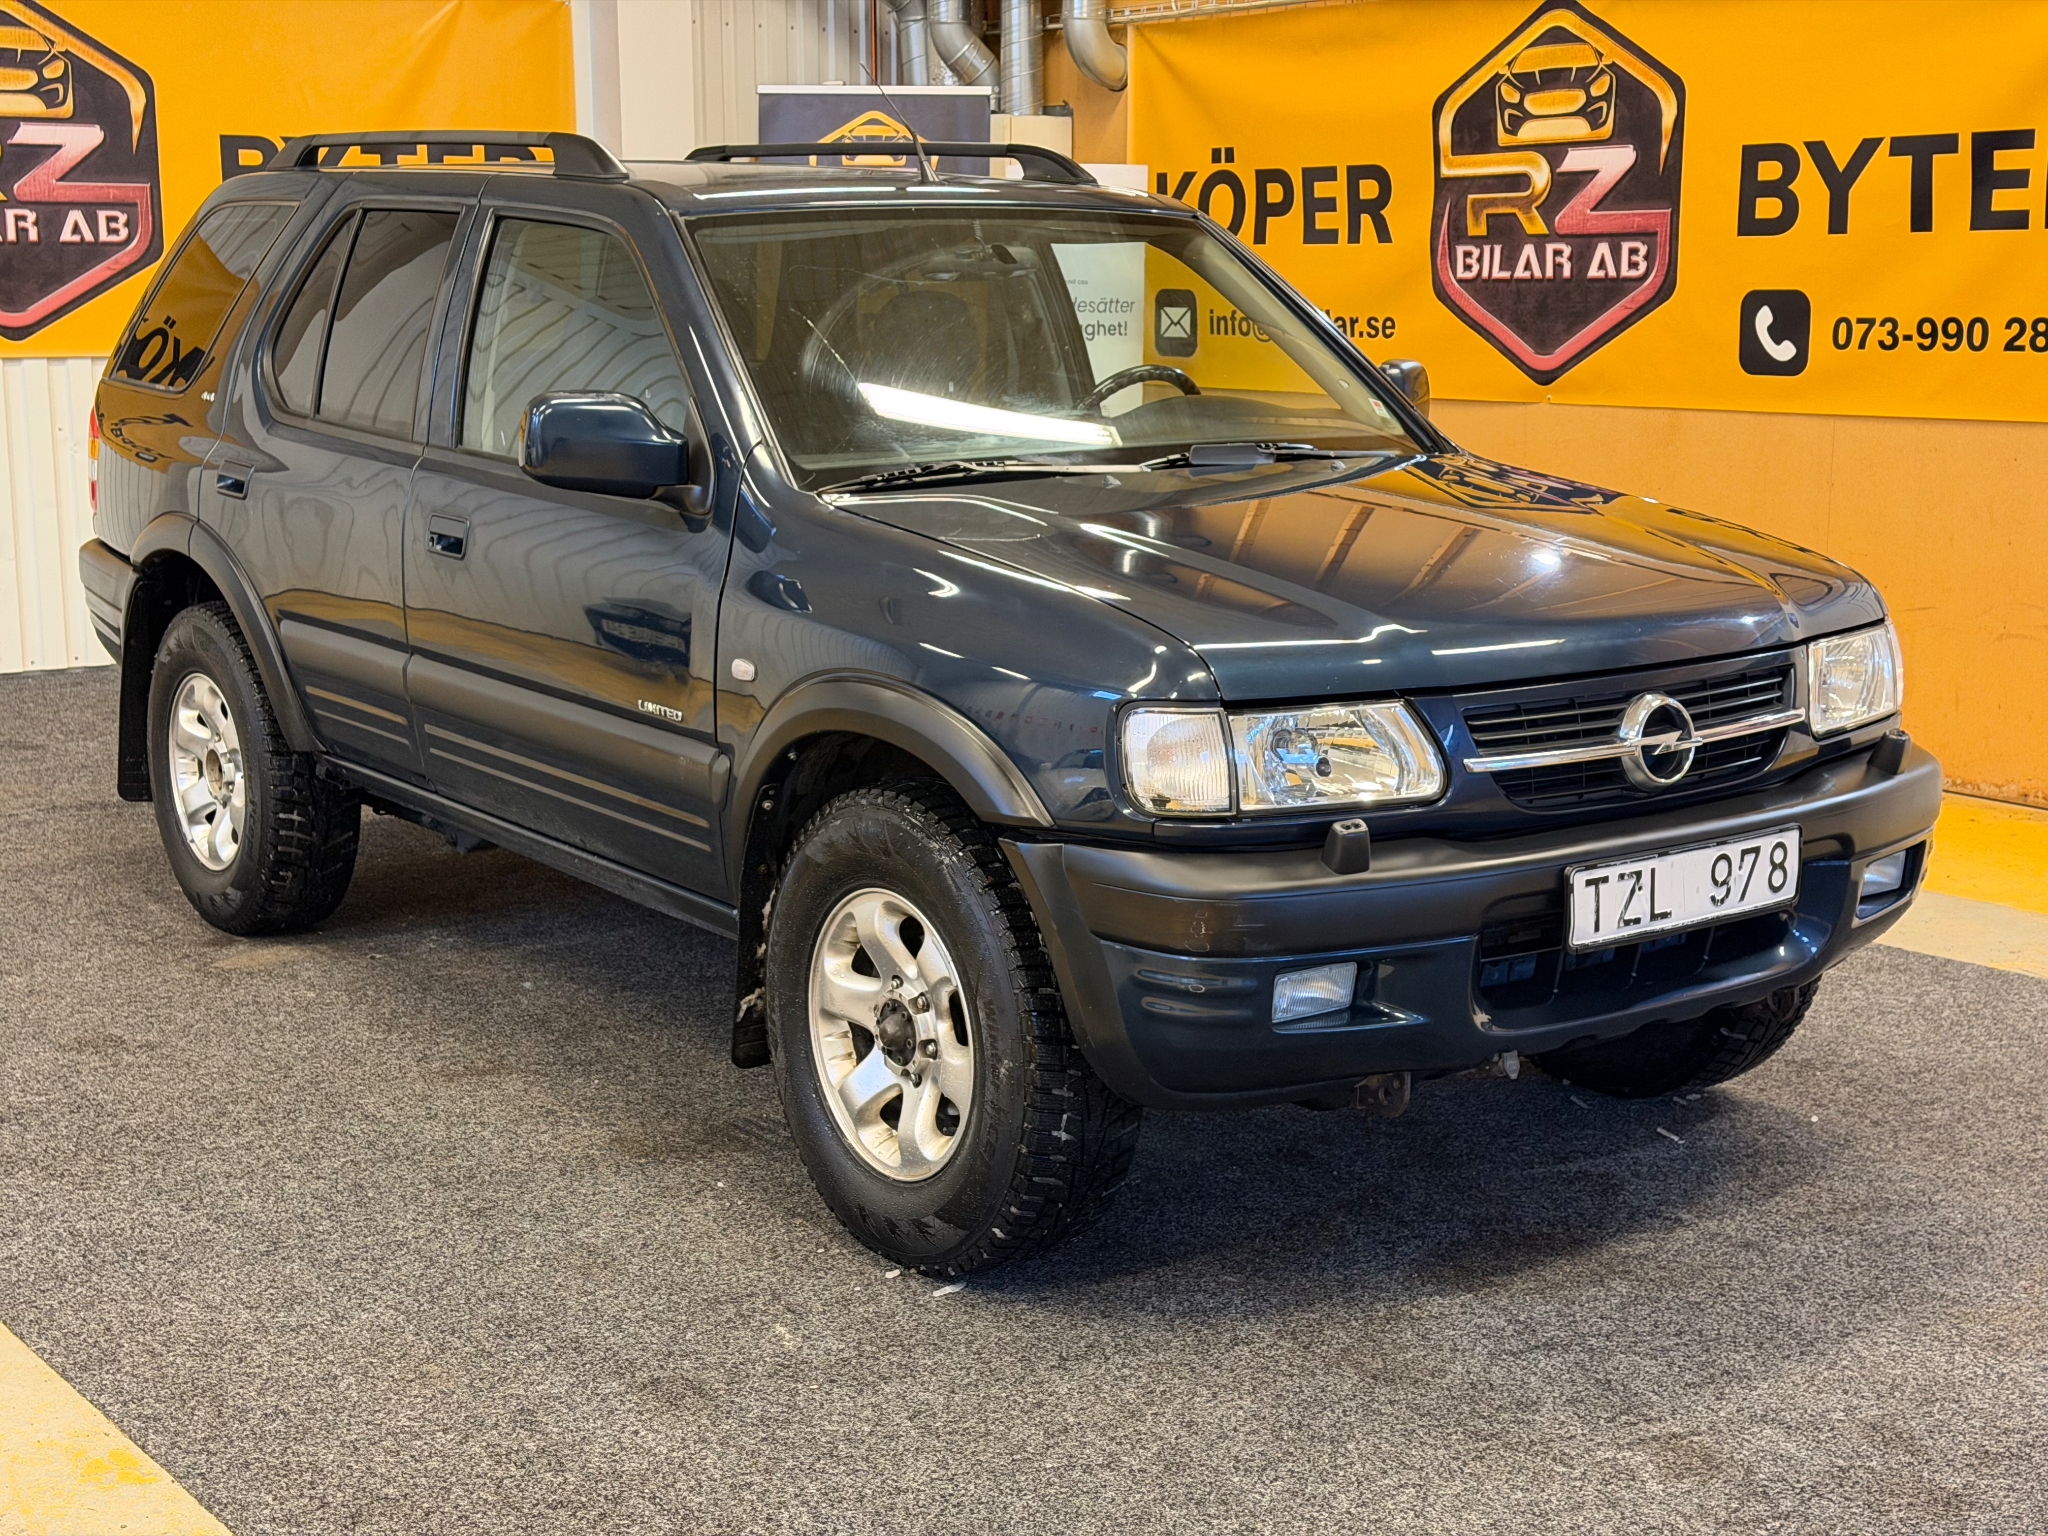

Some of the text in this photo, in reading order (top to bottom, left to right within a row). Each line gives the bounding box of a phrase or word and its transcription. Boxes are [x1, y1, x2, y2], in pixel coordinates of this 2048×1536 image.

[1440, 144, 1671, 237] RZ
[1737, 128, 2048, 237] BYTE
[59, 208, 129, 243] AB
[1455, 240, 1648, 280] BILAR AB
[1080, 319, 1128, 342] ghet!
[1832, 316, 2048, 353] 073-990 28
[1584, 840, 1789, 934] TZL 978
